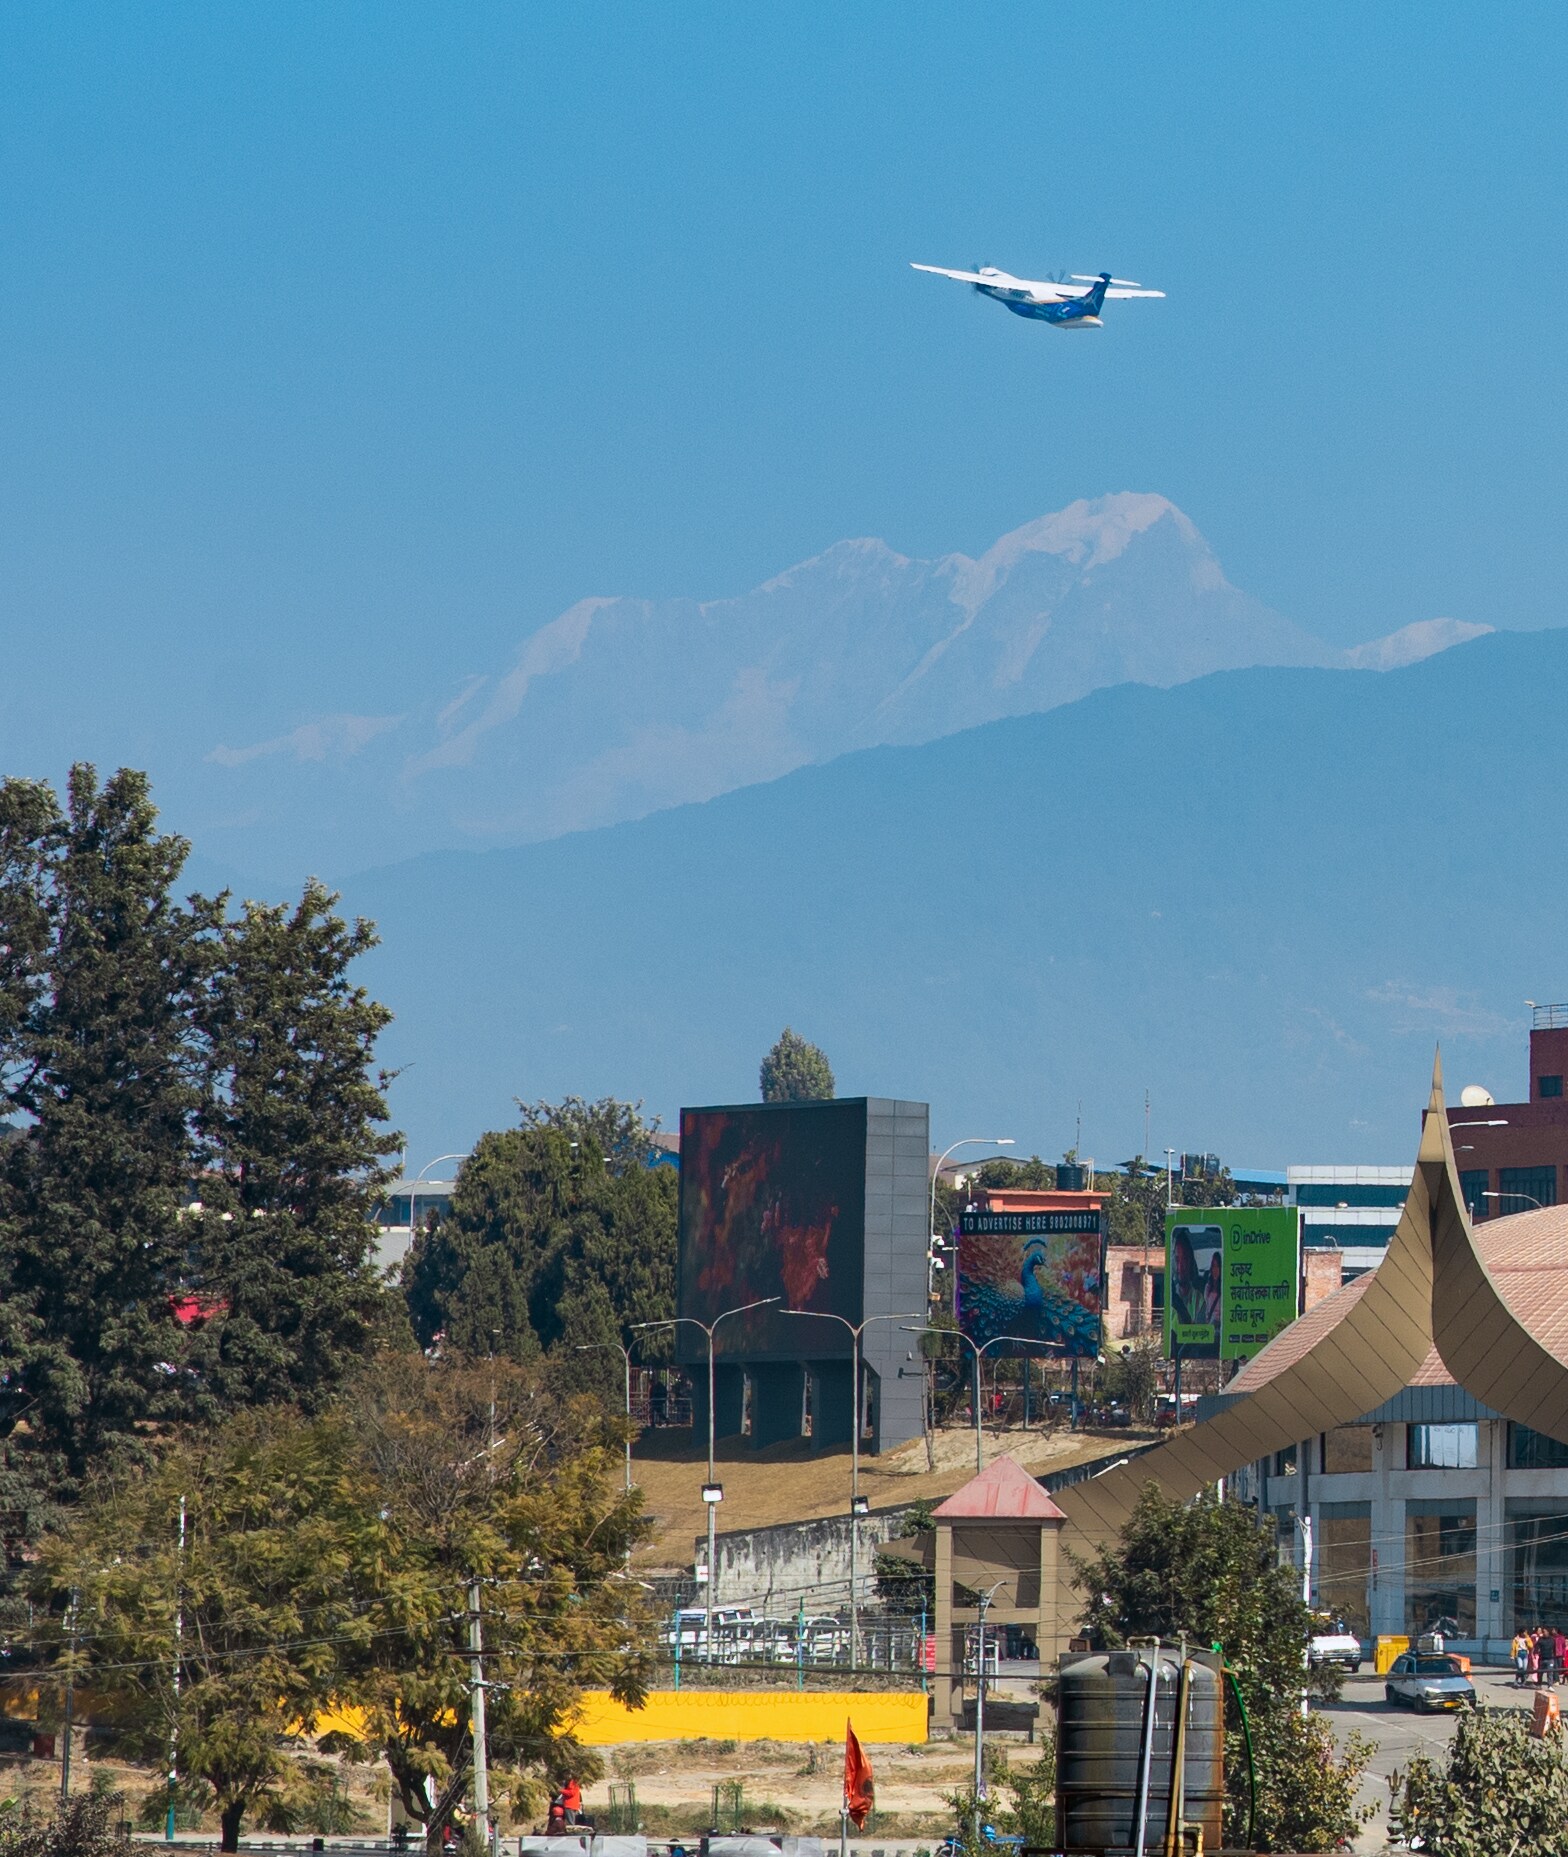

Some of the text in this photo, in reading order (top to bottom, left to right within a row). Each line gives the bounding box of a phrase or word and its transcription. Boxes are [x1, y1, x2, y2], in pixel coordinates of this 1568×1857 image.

[963, 1217, 974, 1231] TO
[977, 1216, 1022, 1231] ADVERTISE
[1025, 1216, 1046, 1230] HERE
[1243, 1230, 1271, 1245] inDrive
[1272, 1280, 1290, 1300] लागि
[1230, 1304, 1265, 1328] उचित मूल्य
